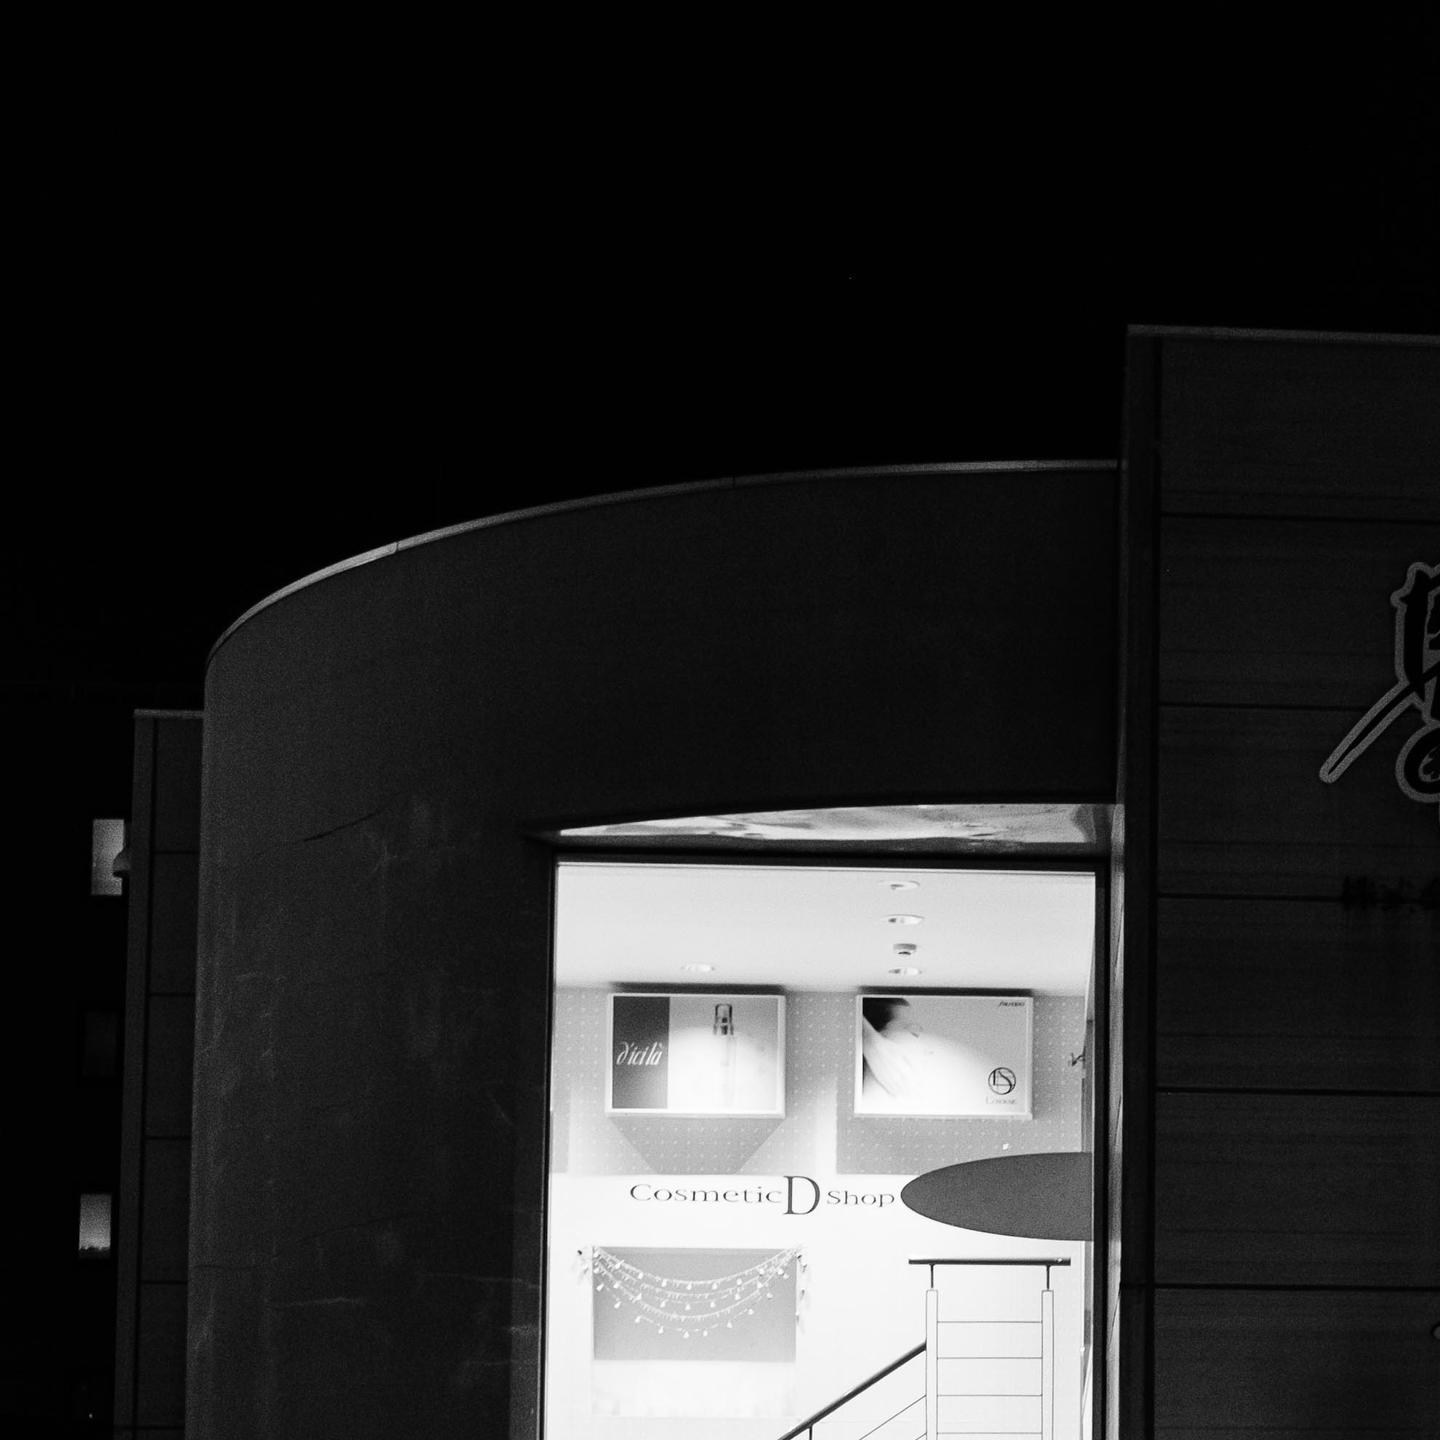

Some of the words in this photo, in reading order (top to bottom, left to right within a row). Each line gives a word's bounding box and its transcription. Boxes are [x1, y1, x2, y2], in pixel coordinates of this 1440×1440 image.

[630, 1184, 783, 1203] Cosmetic
[783, 1175, 820, 1215] D
[826, 1190, 895, 1208] Shop
